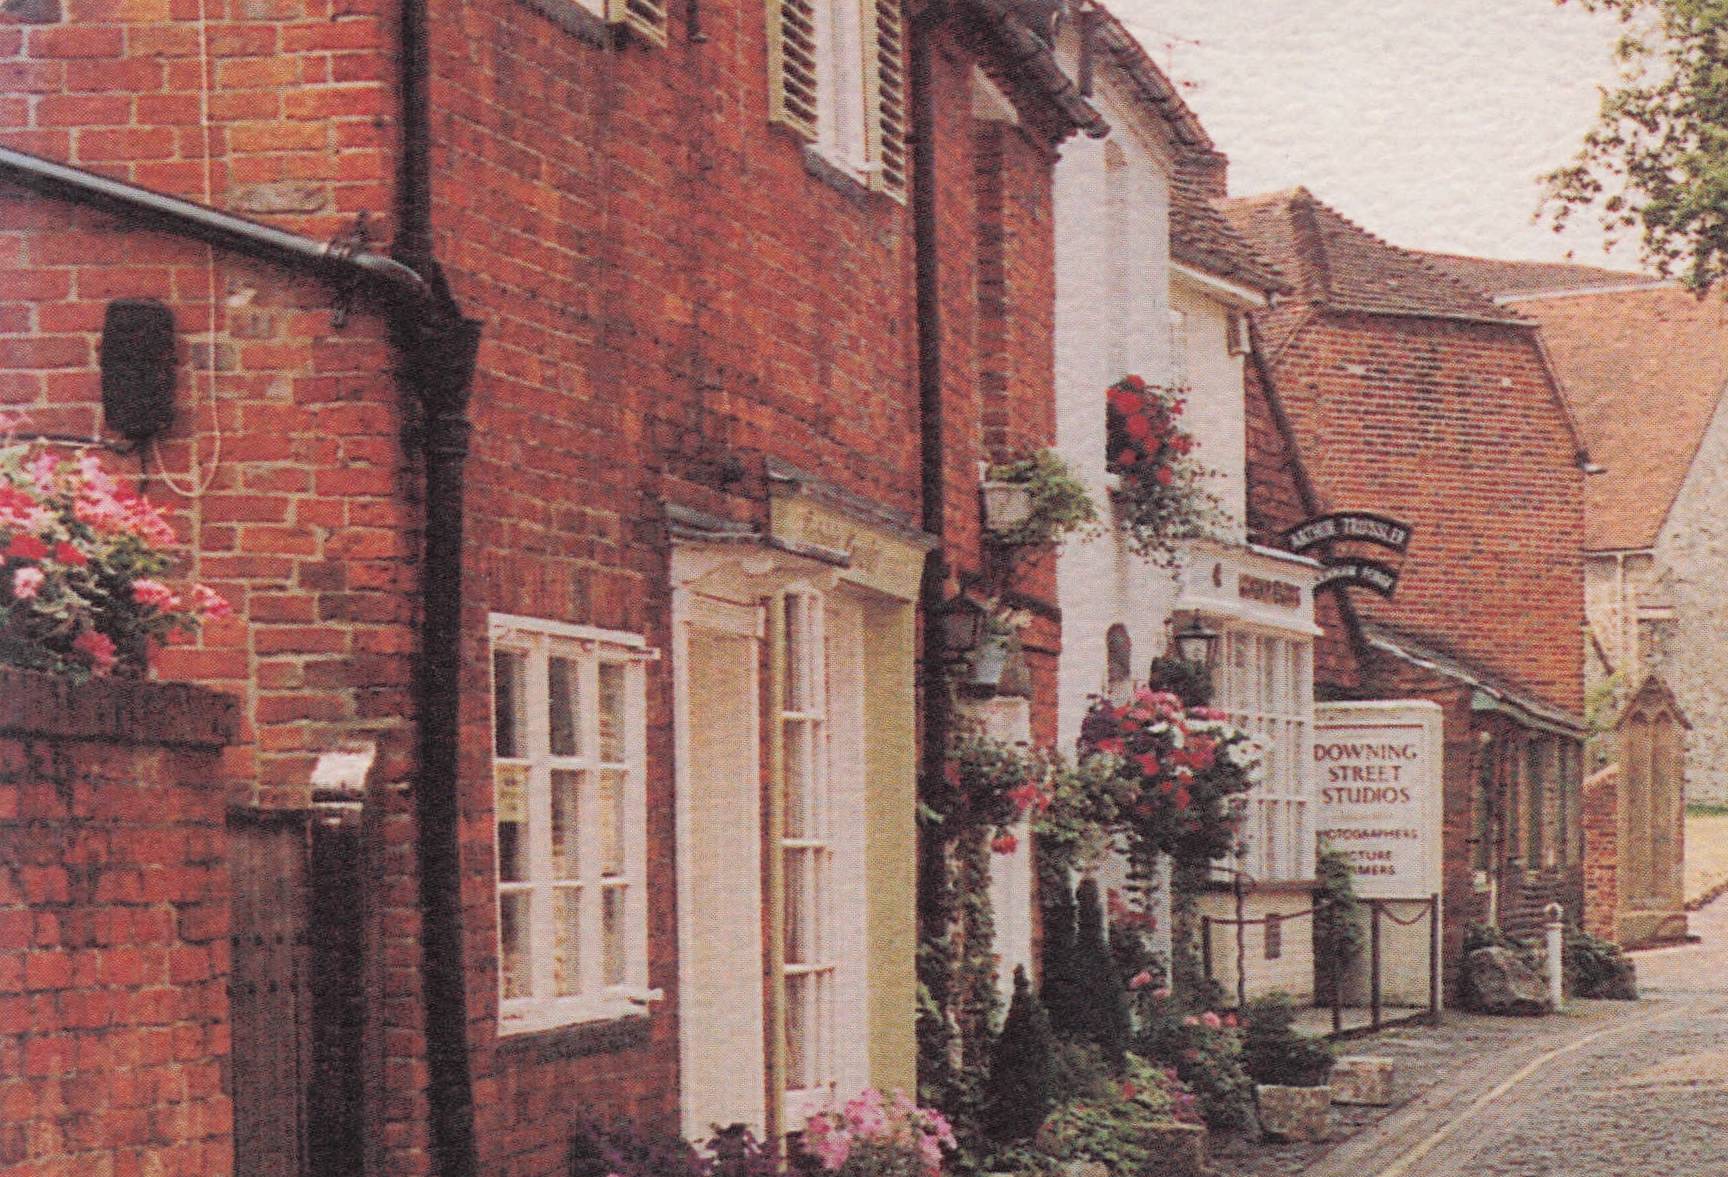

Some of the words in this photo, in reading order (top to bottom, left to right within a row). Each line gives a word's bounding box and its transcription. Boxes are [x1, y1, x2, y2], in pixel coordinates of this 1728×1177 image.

[1313, 743, 1417, 761] DOWNING
[1328, 765, 1401, 782] STREET
[1321, 785, 1410, 805] STUDIOS
